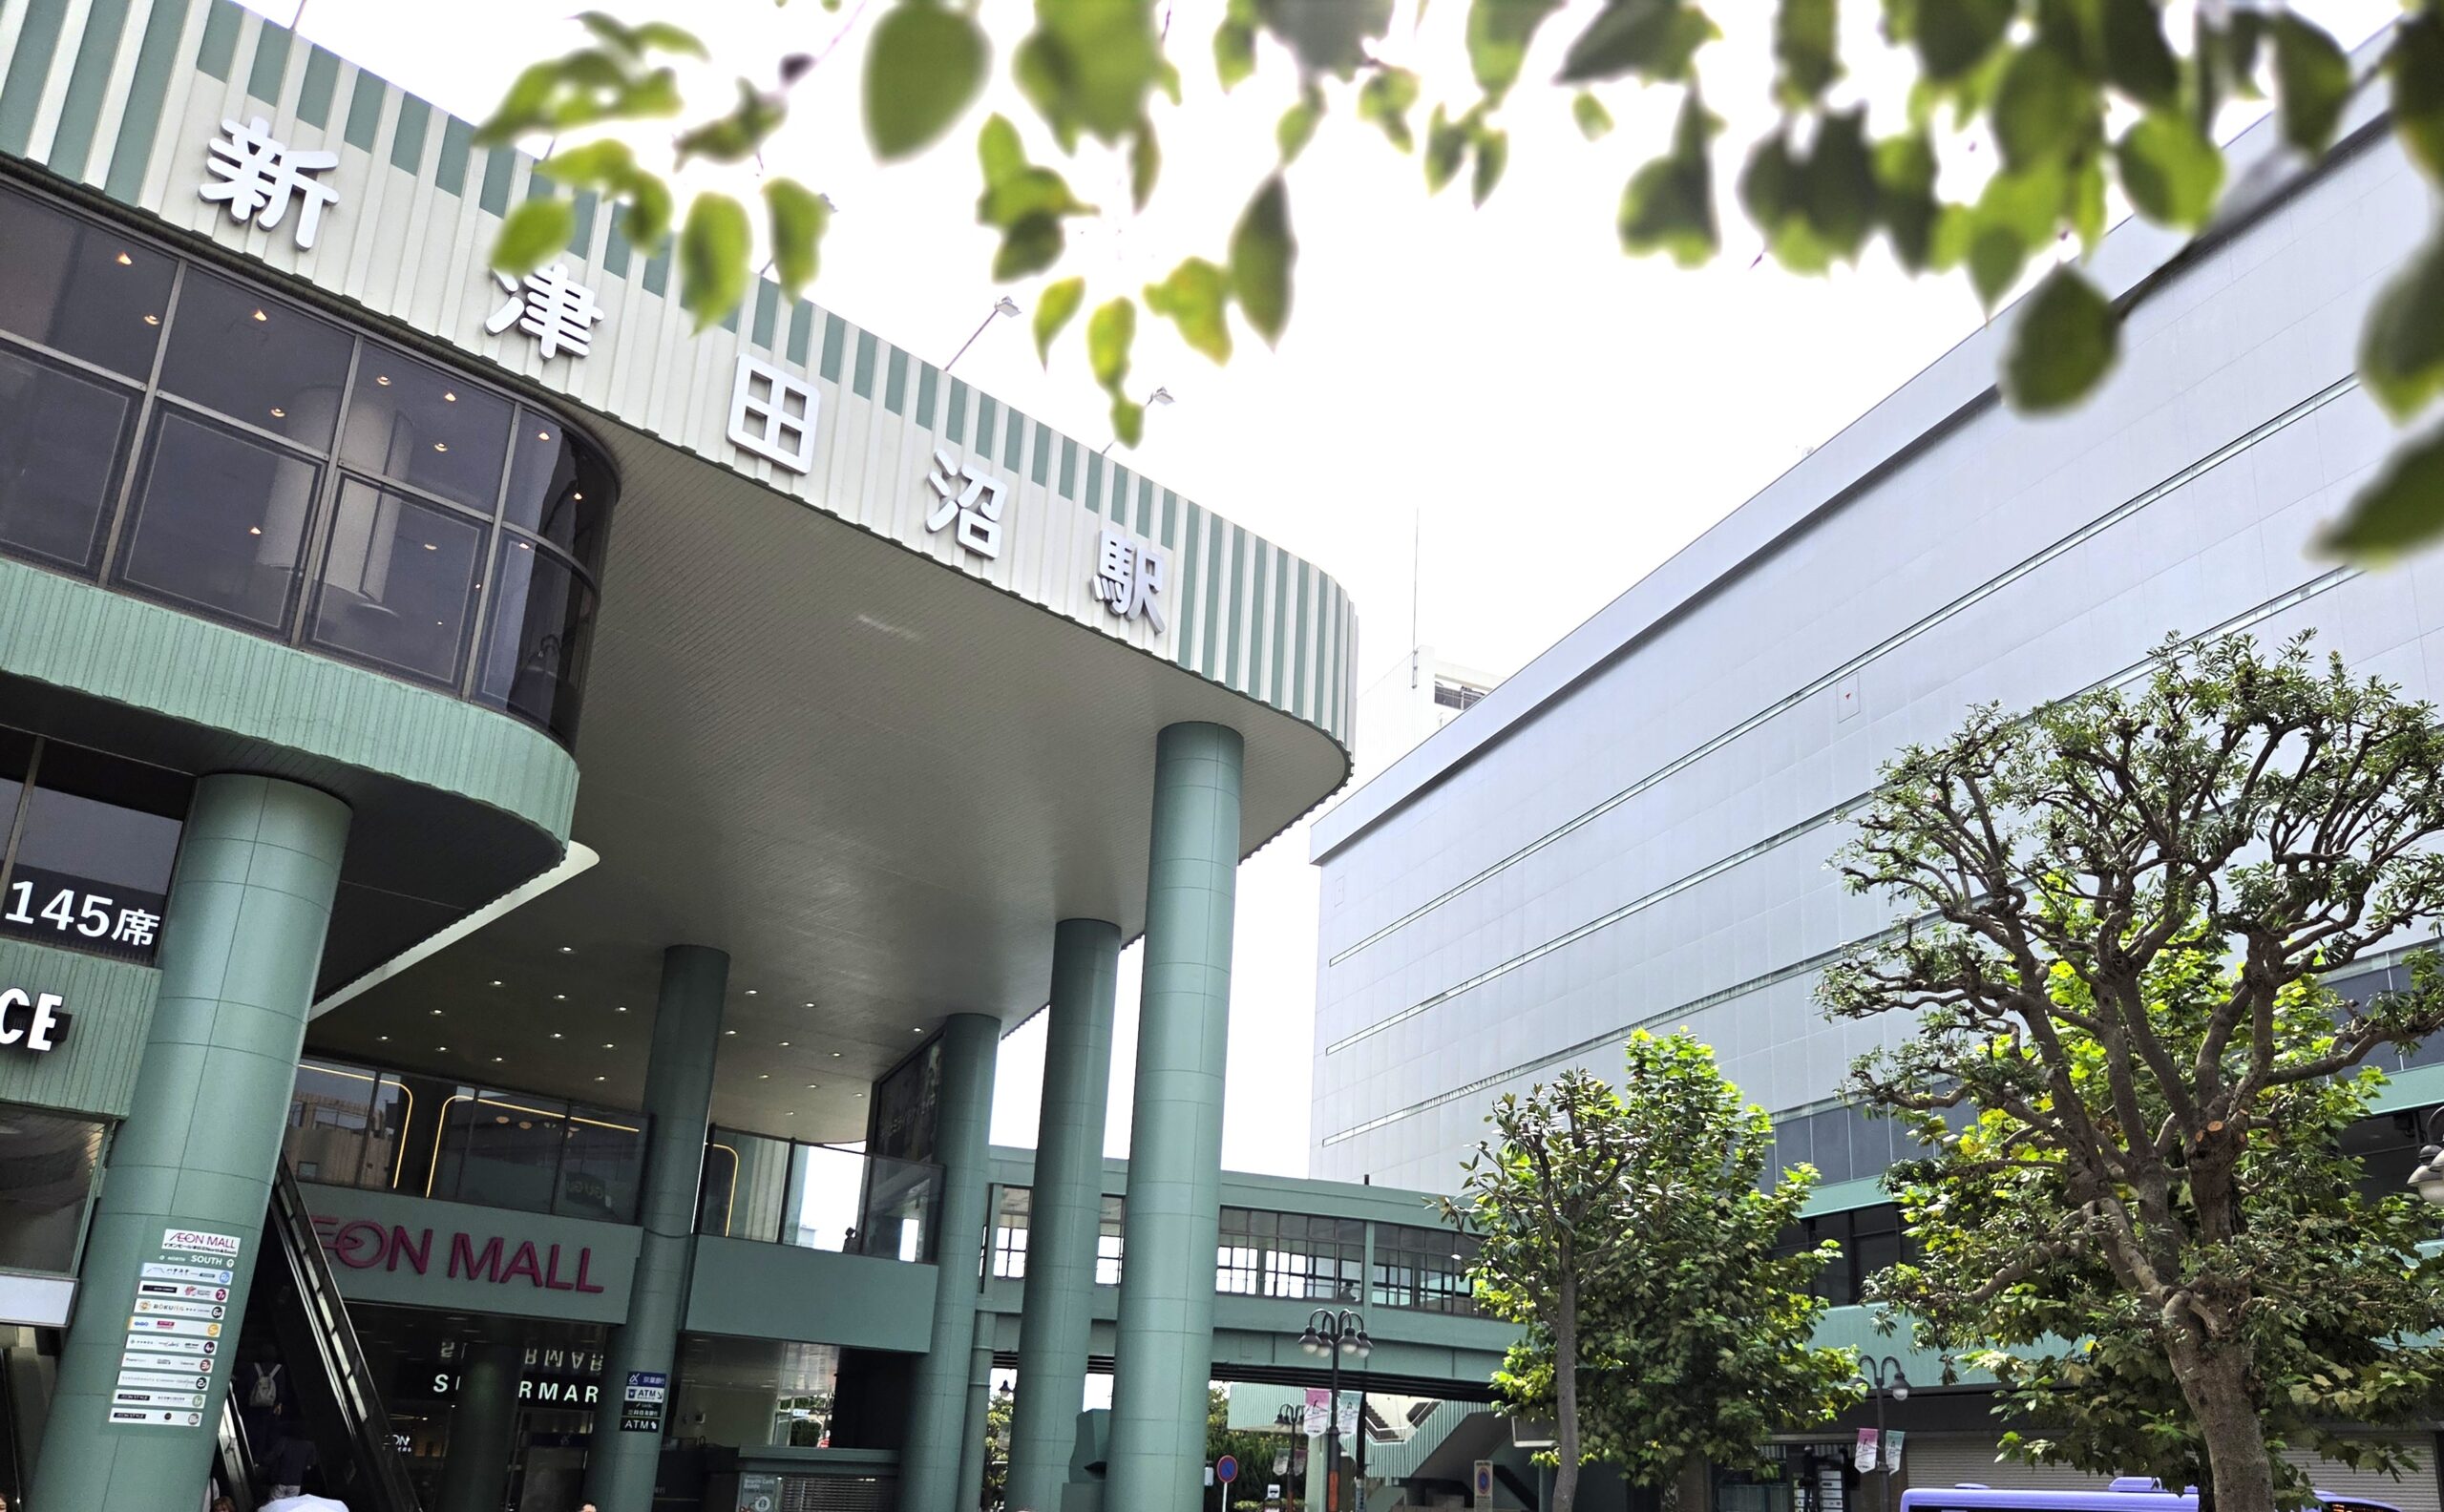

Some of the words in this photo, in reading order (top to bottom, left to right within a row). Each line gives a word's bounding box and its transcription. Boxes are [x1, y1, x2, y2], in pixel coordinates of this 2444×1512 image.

[199, 115, 1169, 634] 新津田沼駅
[5, 880, 160, 946] 145席
[206, 1236, 236, 1249] MALL
[191, 1254, 222, 1265] SOUTH
[448, 1231, 604, 1293] MALL
[638, 1389, 656, 1397] ATM
[624, 1420, 649, 1430] ATM
